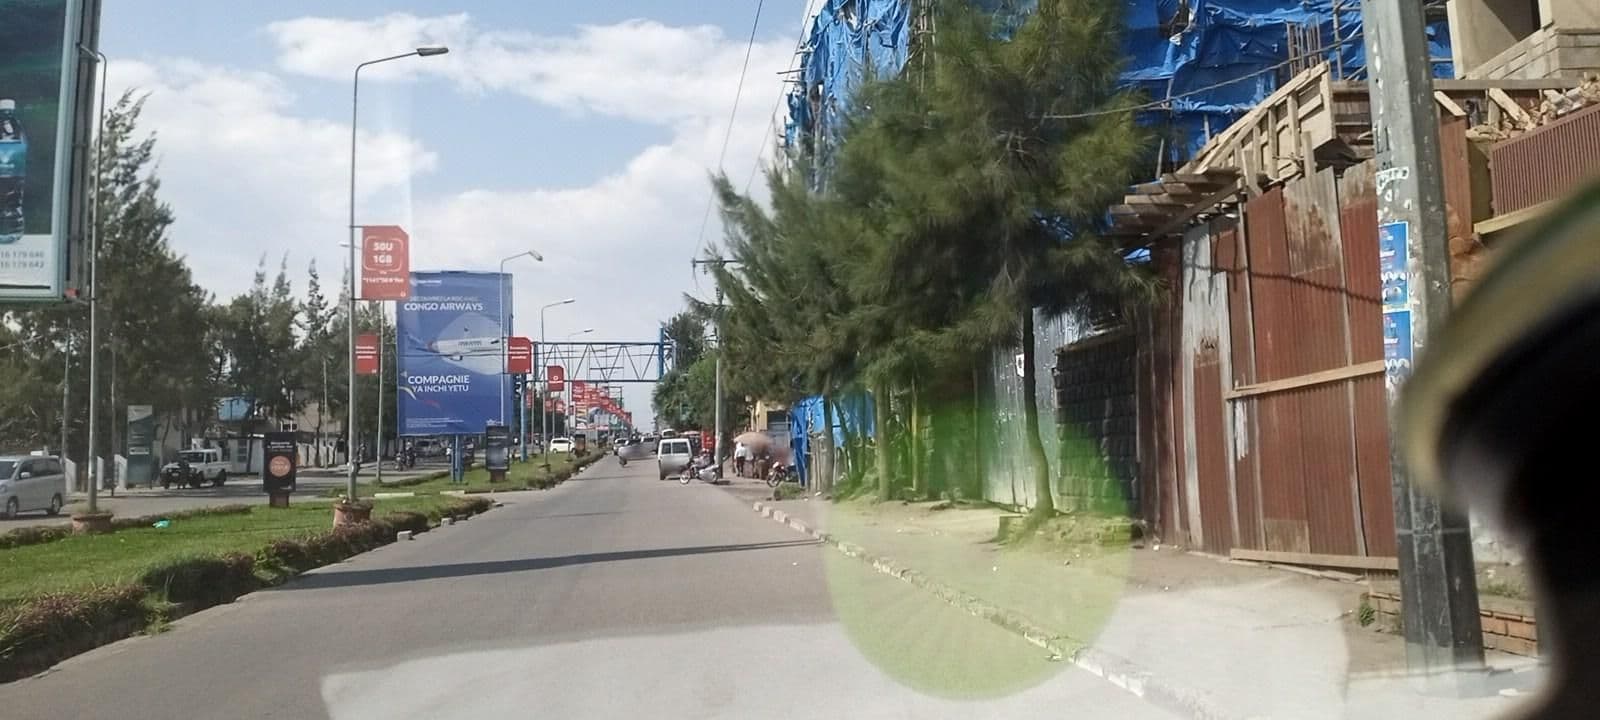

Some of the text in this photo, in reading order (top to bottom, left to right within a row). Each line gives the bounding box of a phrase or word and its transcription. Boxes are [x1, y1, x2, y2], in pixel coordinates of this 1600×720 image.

[404, 302, 483, 311] CONGO AIRWAYS
[408, 375, 470, 385] COMPAGNIE
[413, 385, 424, 393] YA
[448, 384, 469, 392] YETU
